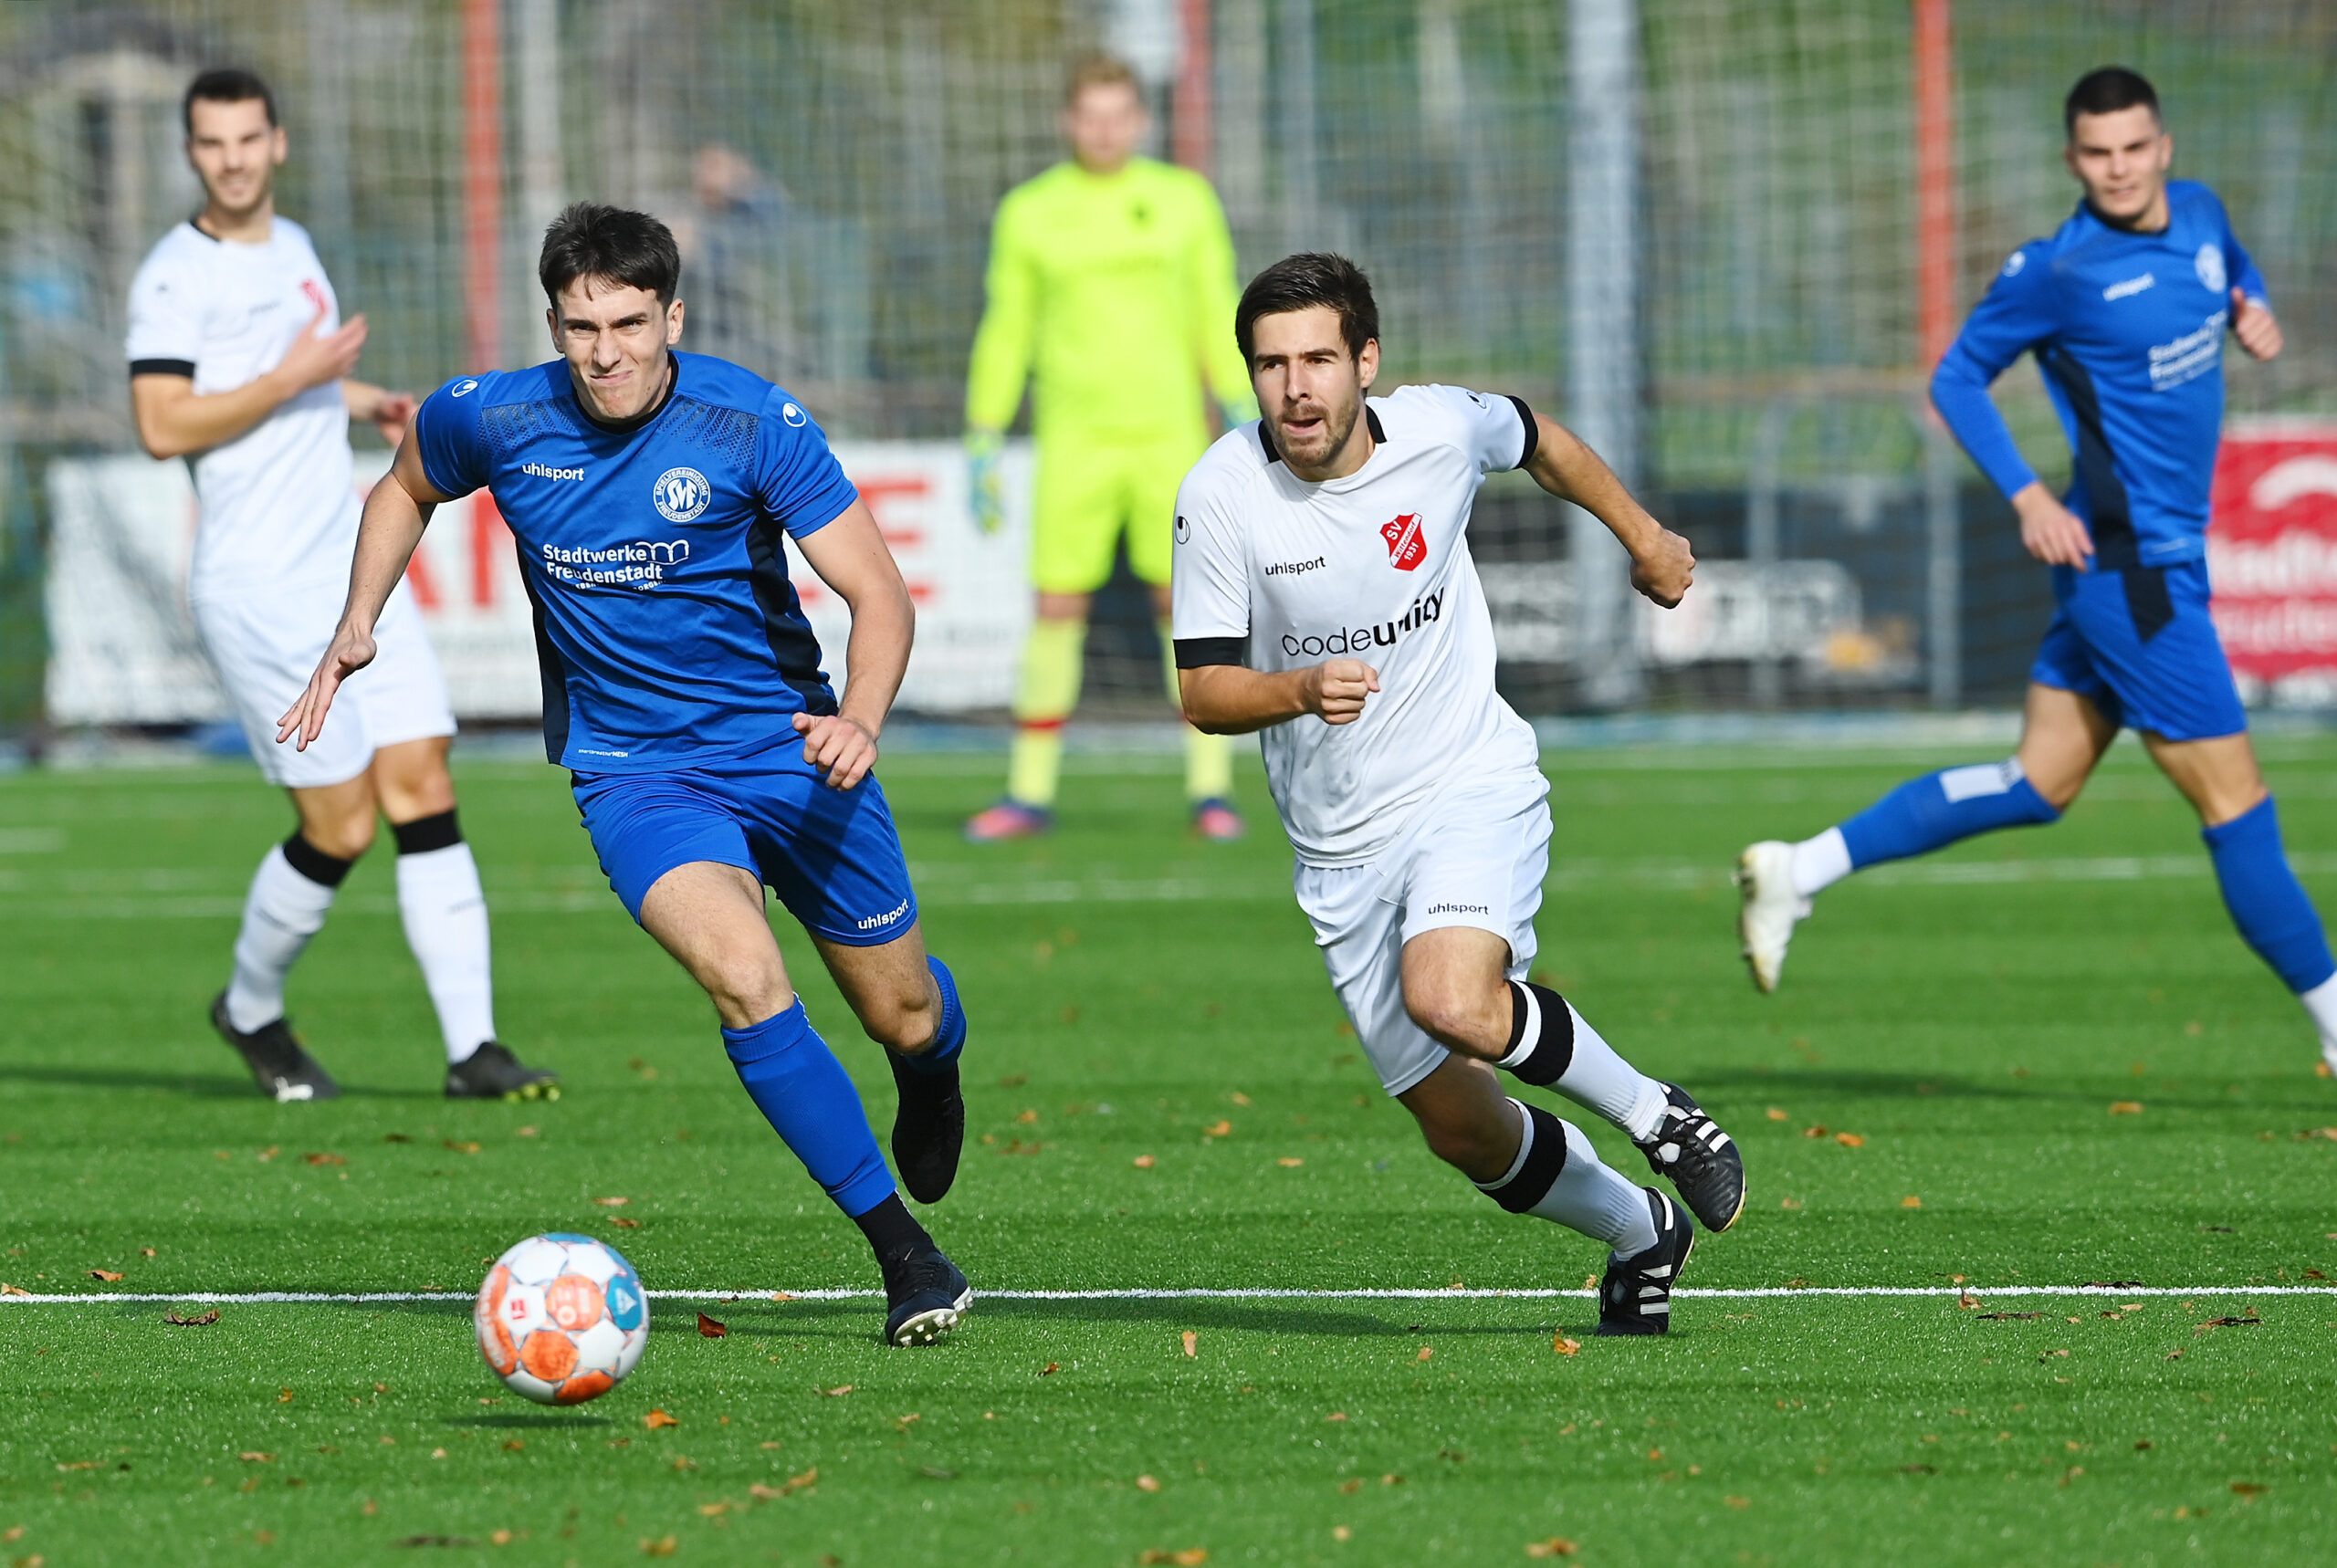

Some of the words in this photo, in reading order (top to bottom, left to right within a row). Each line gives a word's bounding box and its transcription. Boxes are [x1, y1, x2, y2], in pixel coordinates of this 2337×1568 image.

[522, 462, 584, 481] uhlsport
[667, 478, 697, 511] SVF
[657, 501, 706, 519] FREUDENSTADT
[1386, 520, 1402, 540] SV
[543, 544, 646, 563] Stadtwerke
[1403, 541, 1420, 560] 1931
[547, 562, 663, 583] Freudenstadt
[1265, 556, 1326, 575] uhlsport
[858, 897, 908, 929] uhlsport
[1428, 903, 1489, 915] uhlsport
